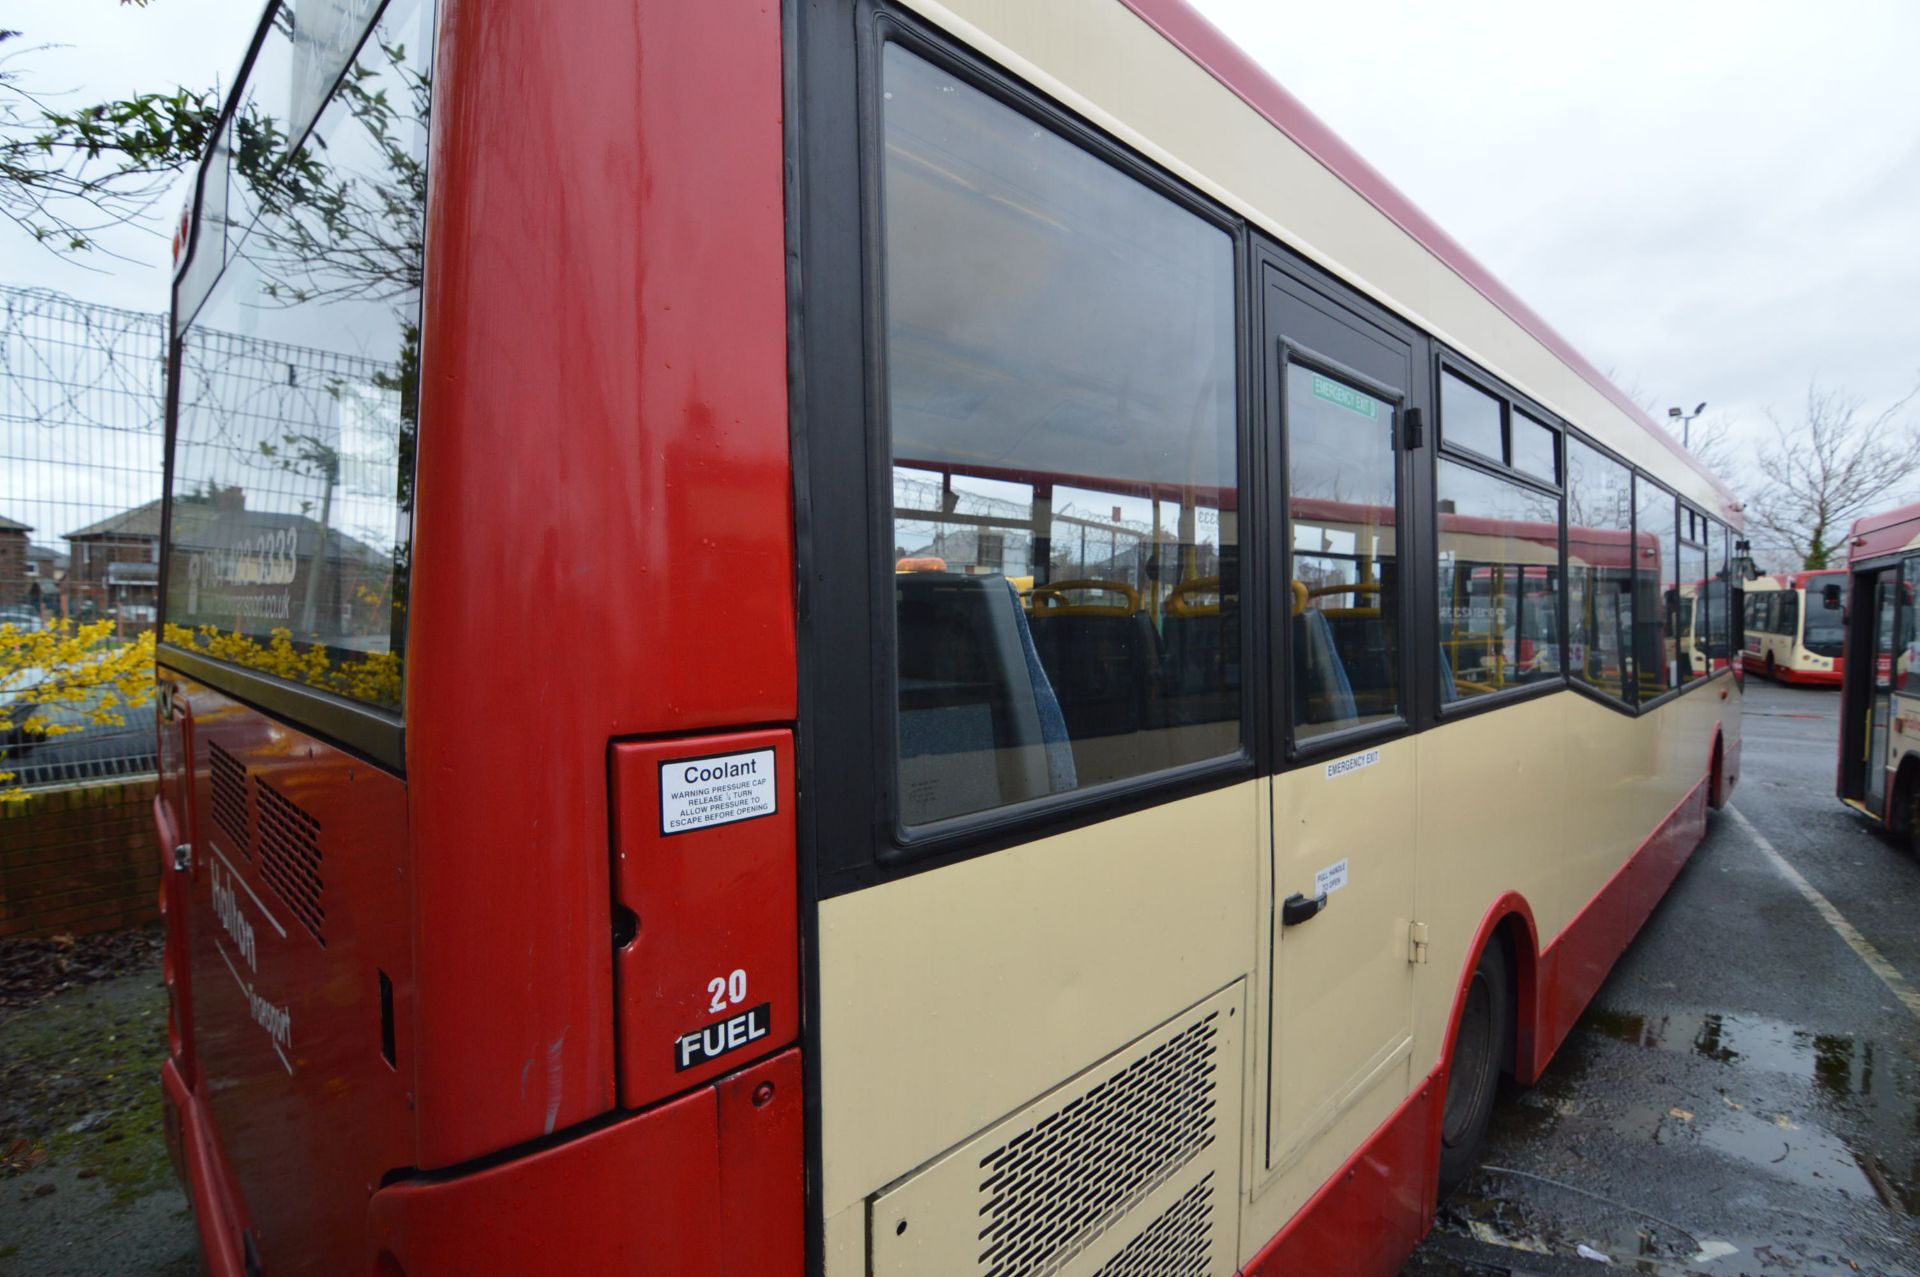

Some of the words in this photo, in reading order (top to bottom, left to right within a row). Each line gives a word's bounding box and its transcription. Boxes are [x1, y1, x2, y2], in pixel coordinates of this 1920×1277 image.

[1314, 379, 1355, 407] EMERGENCY
[256, 525, 297, 585] 3333
[684, 758, 757, 784] Coolant
[1328, 755, 1366, 777] EMERGENCY
[1366, 751, 1378, 764] EXIT
[671, 787, 710, 800] WARNING
[711, 780, 750, 794] PRESSURE
[752, 778, 767, 788] CAP
[688, 794, 723, 806] RELEASE
[733, 789, 753, 799] TURN
[670, 815, 703, 828] ESCAPE
[704, 809, 735, 822] BEFORE
[736, 803, 769, 815] OPENING
[680, 805, 708, 817] ALLOW
[710, 798, 748, 812] PRESSURE
[751, 796, 761, 804] TO
[707, 968, 747, 1014] 20
[682, 1011, 766, 1067] FUEL
